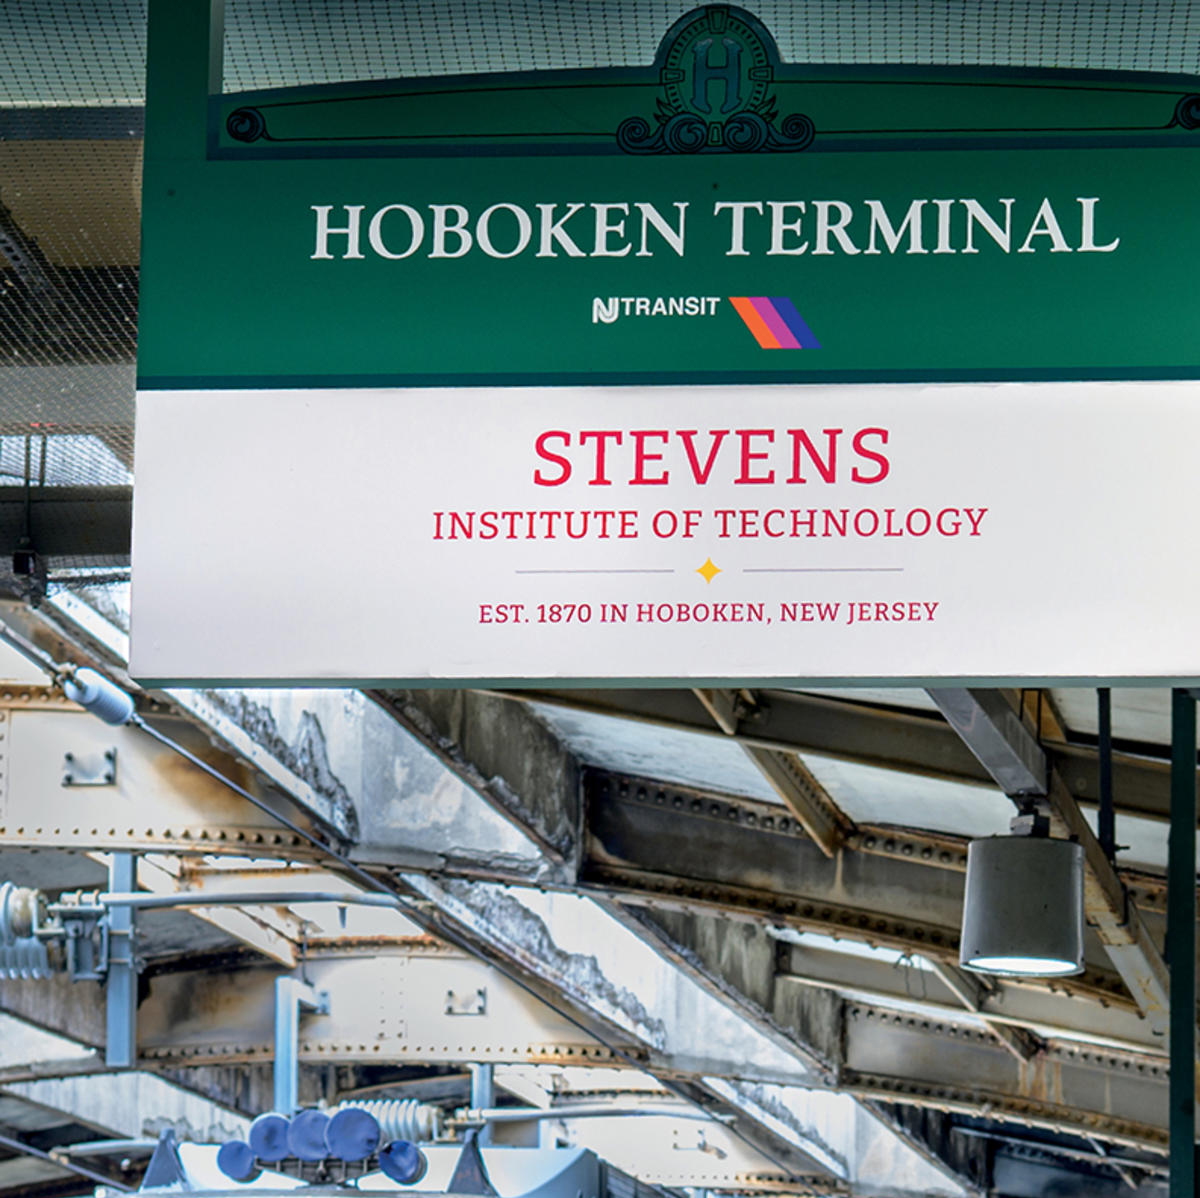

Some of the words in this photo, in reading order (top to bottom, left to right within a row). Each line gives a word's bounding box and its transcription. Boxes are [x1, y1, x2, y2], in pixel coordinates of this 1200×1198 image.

[310, 202, 690, 259] HOBOKEN
[714, 197, 1121, 256] TERMINAL
[533, 427, 891, 487] STEVENS
[432, 510, 640, 540] INSTITUTE
[651, 509, 703, 539] OF
[713, 507, 989, 538] TECHNOLOGY
[478, 603, 530, 624] EST.
[536, 603, 592, 623] 1870
[600, 603, 629, 623] IN
[636, 602, 773, 625] HOBOKEN,
[780, 602, 841, 622] NEW
[846, 601, 940, 625] JERSEY
